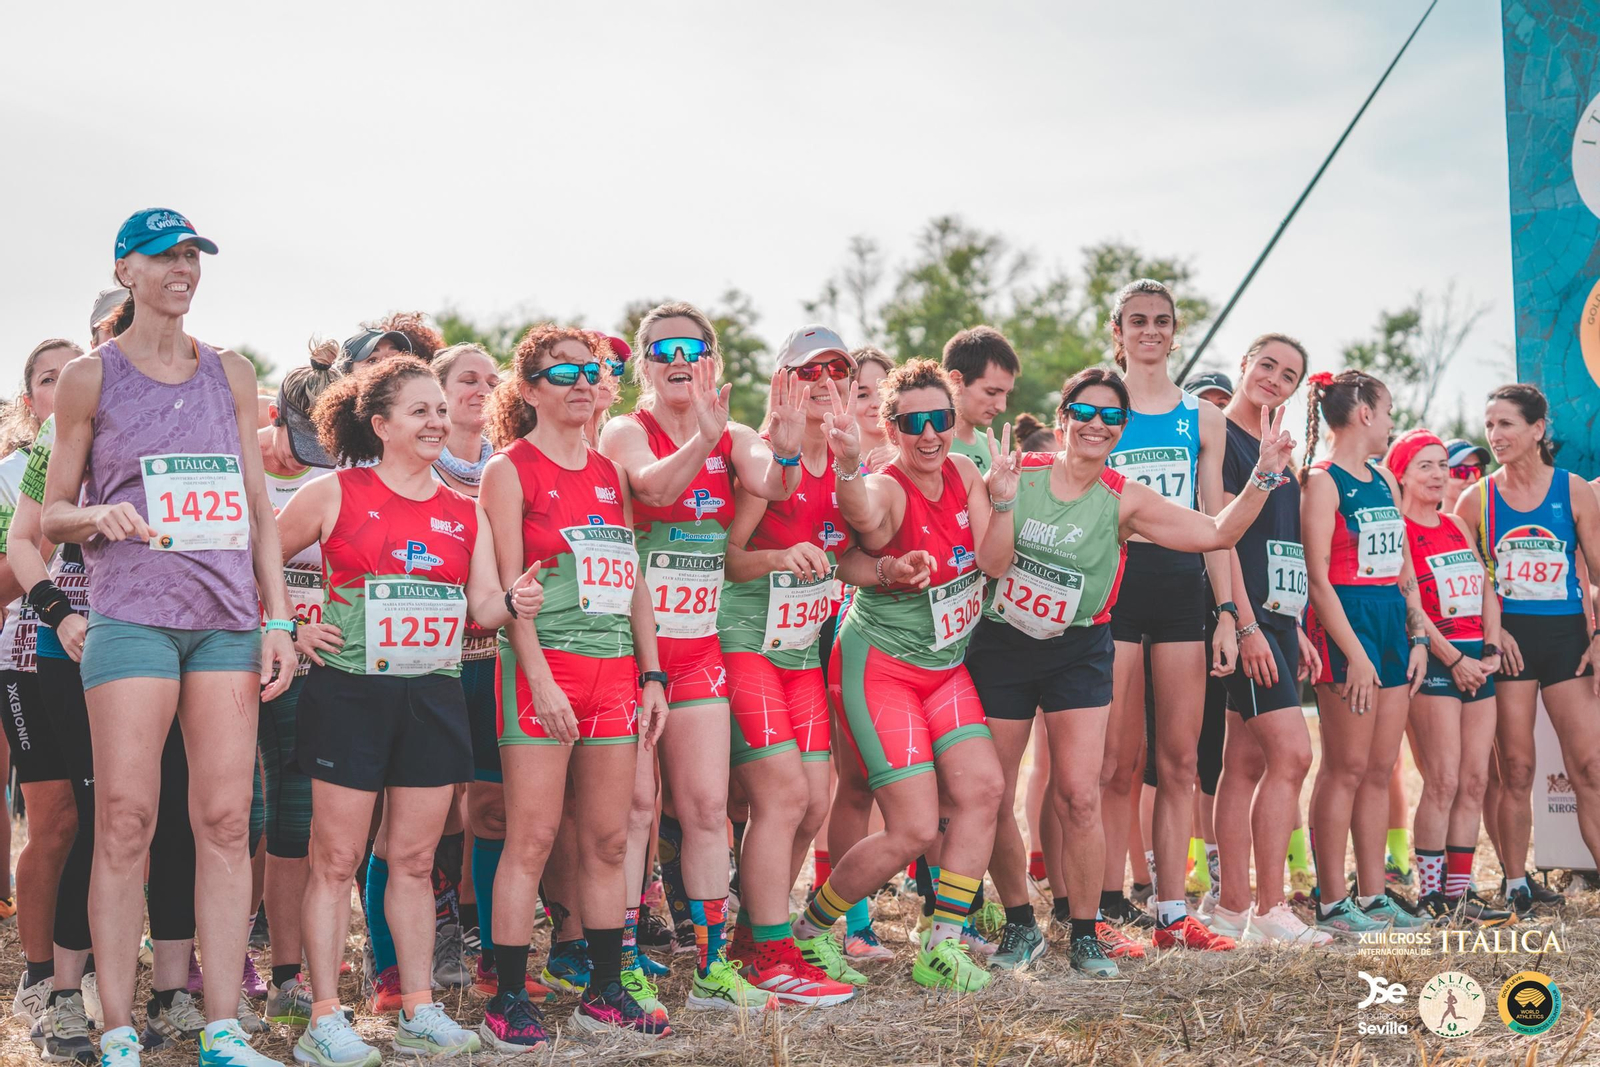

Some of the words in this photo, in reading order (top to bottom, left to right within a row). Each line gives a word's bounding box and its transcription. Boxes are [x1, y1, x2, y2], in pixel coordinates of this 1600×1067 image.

[174, 457, 220, 470] ITÁLICA
[1131, 449, 1170, 462] ITÁLICA
[160, 491, 243, 523] 1425
[588, 528, 623, 540] ITÁLICA
[1018, 518, 1059, 548] ATARFE
[407, 540, 438, 563] Poncho
[1017, 540, 1052, 554] Atletismo
[1054, 549, 1078, 560] Atarfe
[1514, 540, 1549, 549] ITÁLICA
[675, 555, 714, 569] ITÁLICA
[1447, 552, 1475, 564] ITÁLICA
[582, 556, 635, 590] 1258
[1022, 560, 1061, 582] ITÁLICA
[1504, 561, 1564, 583] 1487
[397, 584, 440, 598] ITÁLICA
[949, 574, 976, 595] ITÁLICA
[654, 585, 718, 614] 1281
[1003, 577, 1067, 624] 1261
[776, 596, 828, 629] 1349
[941, 591, 980, 640] 1306
[379, 616, 459, 647] 1257
[1548, 803, 1578, 813] KIROS
